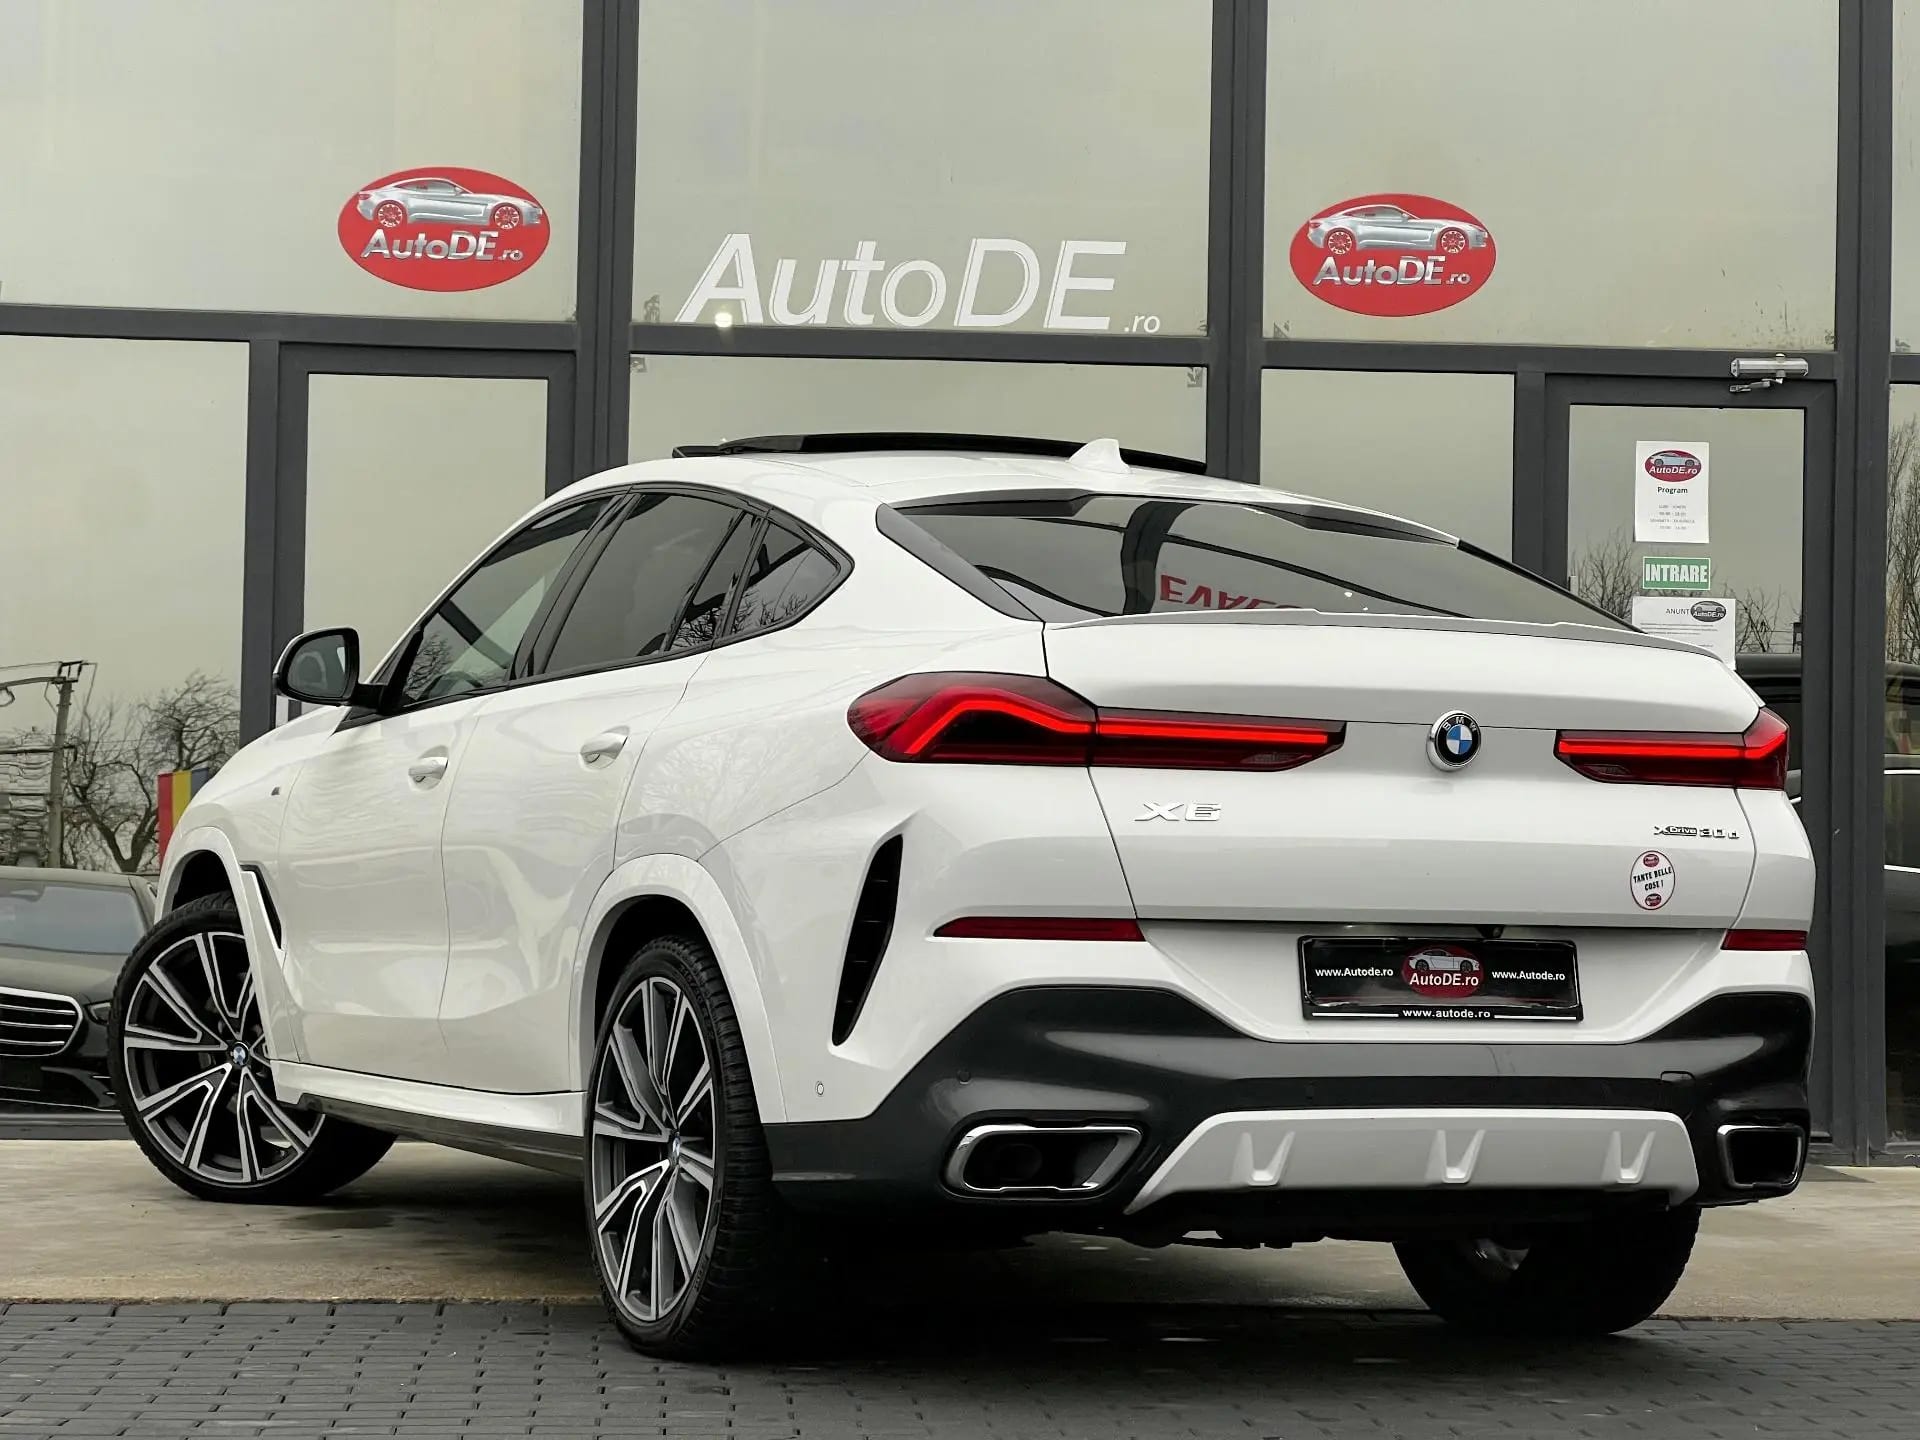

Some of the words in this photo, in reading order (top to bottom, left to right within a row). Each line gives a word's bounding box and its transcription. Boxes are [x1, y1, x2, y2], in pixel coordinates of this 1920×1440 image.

[1649, 466, 1698, 475] AutoDE.ro
[1657, 486, 1688, 495] Program
[1645, 563, 1708, 582] INTRARE
[1442, 716, 1477, 732] BMW
[1134, 801, 1222, 822] X6
[1633, 871, 1653, 884] TANTE
[1653, 866, 1672, 878] BELLE
[1315, 966, 1394, 978] www.Autode.ro
[1491, 969, 1566, 981] www.Autode.ro
[1409, 972, 1479, 987] AutoDE.ro
[1402, 1008, 1491, 1019] www.autode.ro
